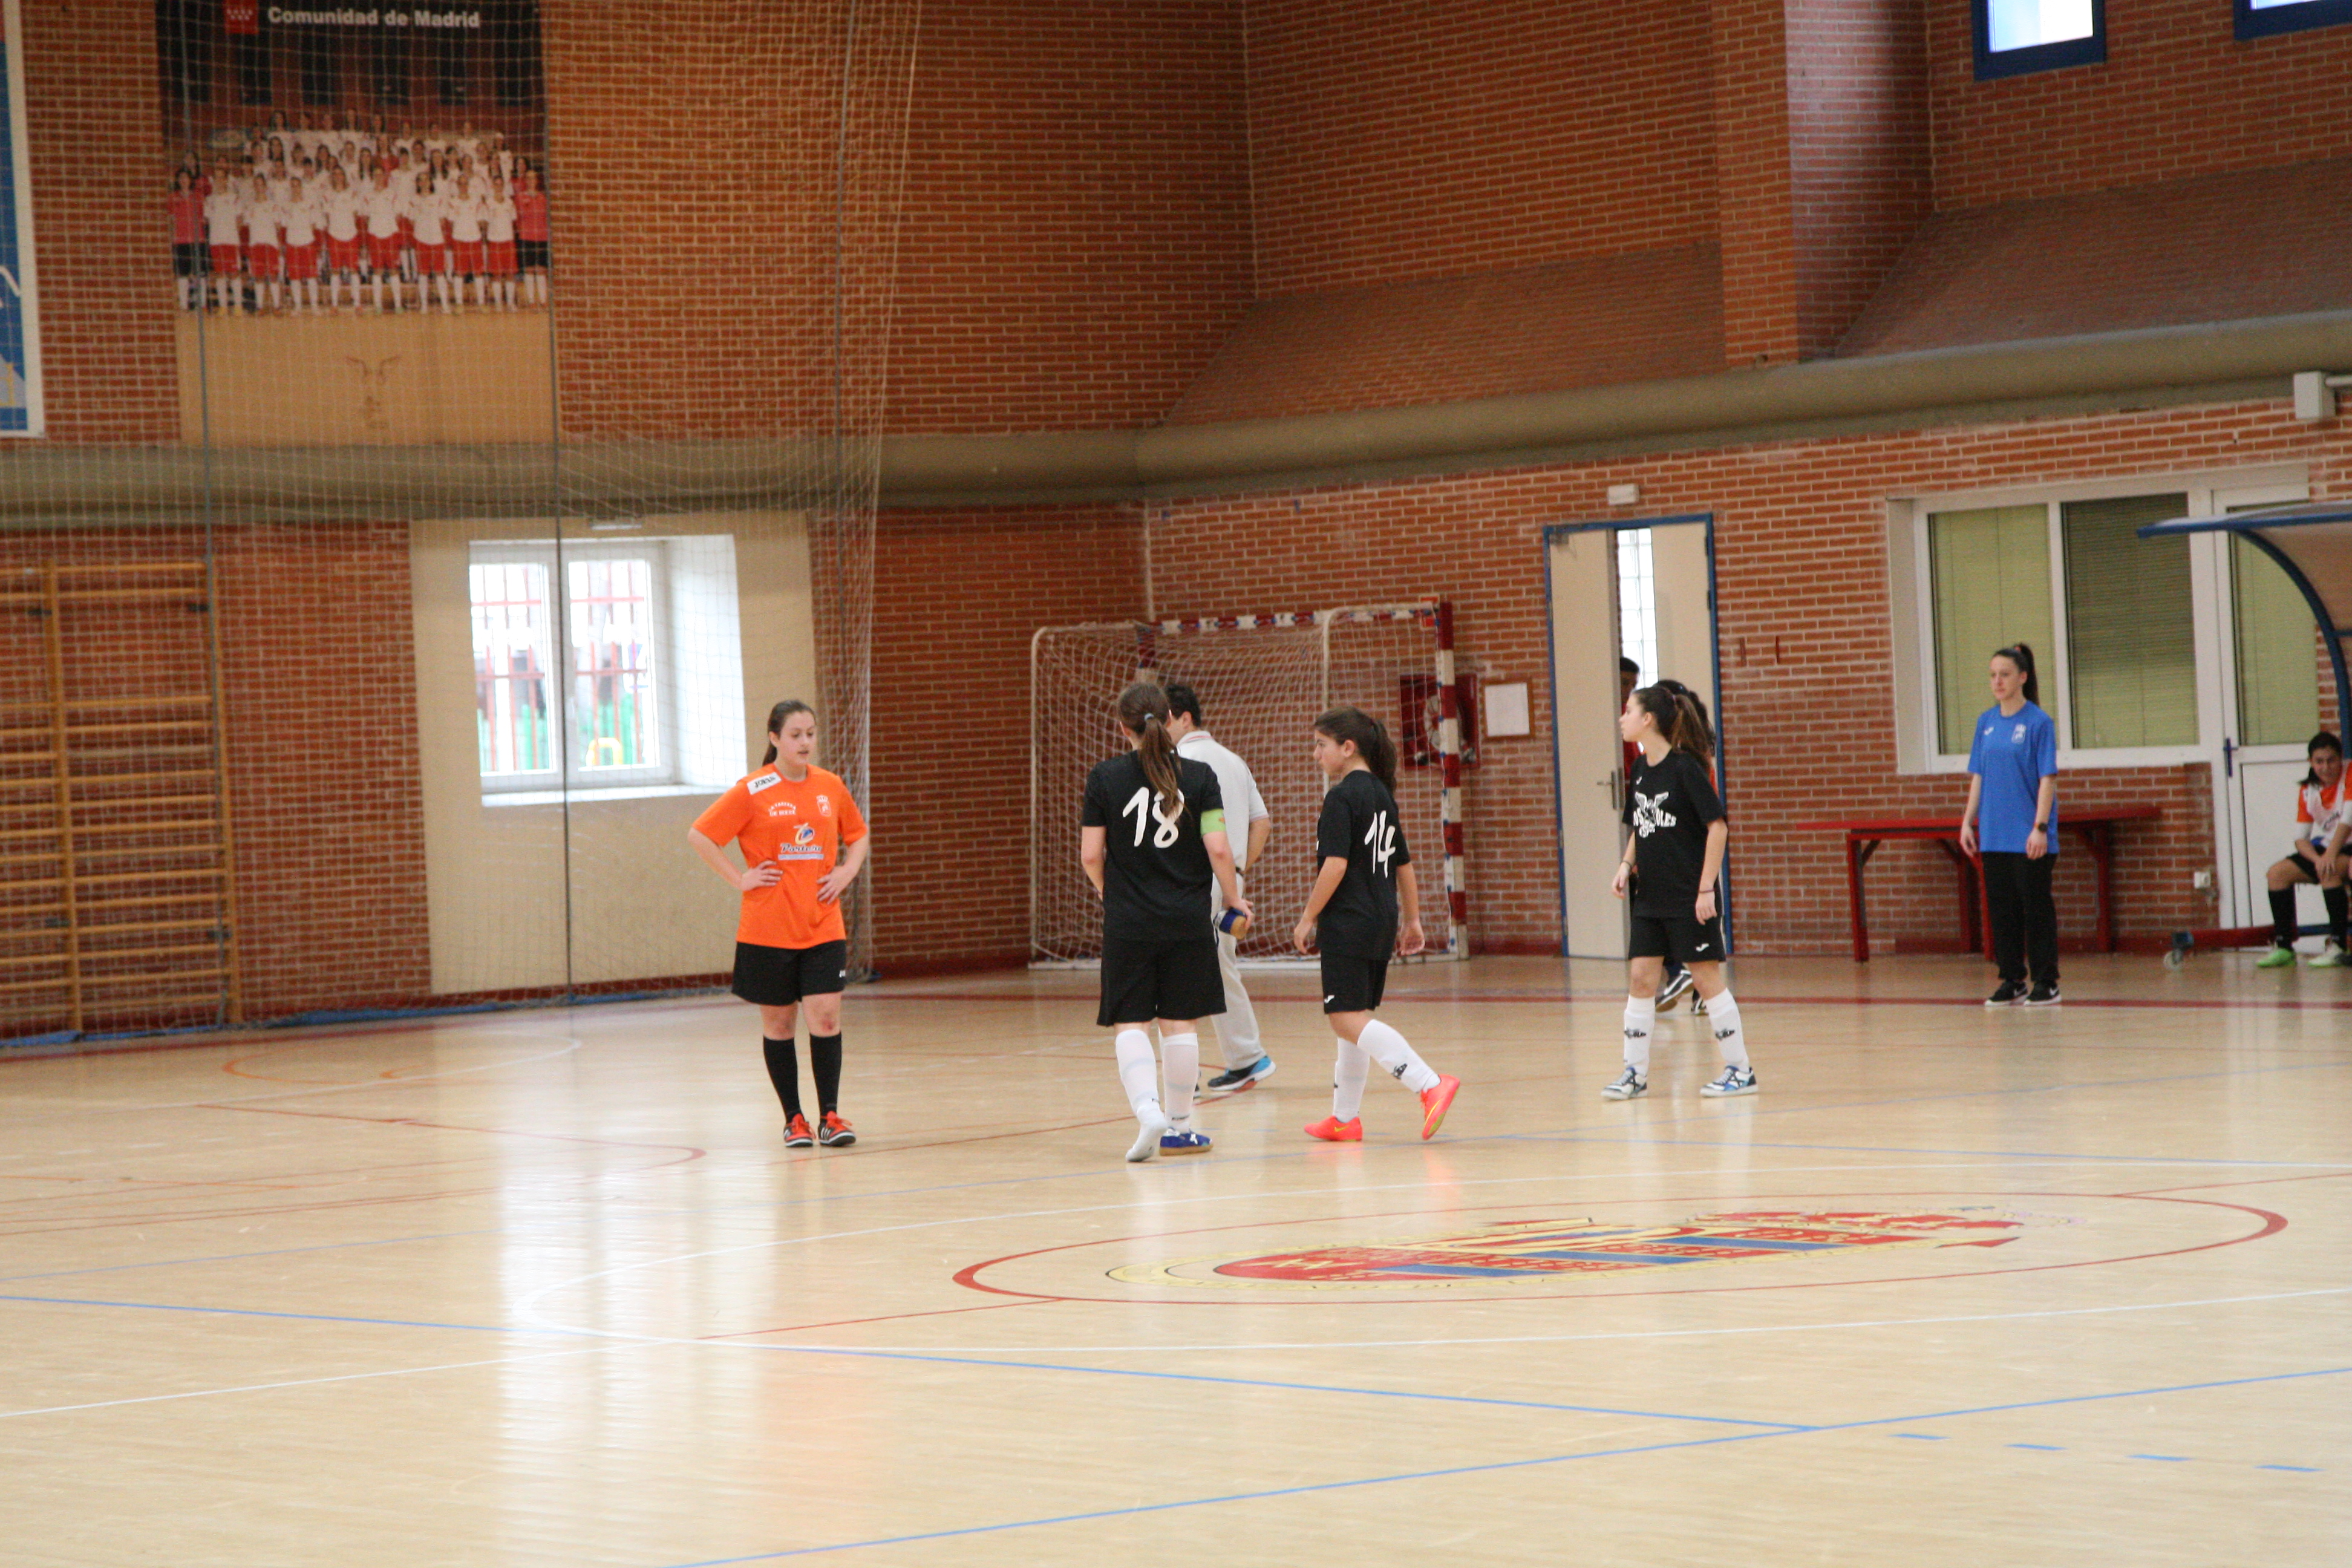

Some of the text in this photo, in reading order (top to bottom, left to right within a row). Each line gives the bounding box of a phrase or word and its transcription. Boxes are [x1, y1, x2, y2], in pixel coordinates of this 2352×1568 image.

[268, 6, 480, 28] Comunidad de Madrid
[1122, 786, 1184, 848] 18
[1364, 810, 1396, 878] 14
